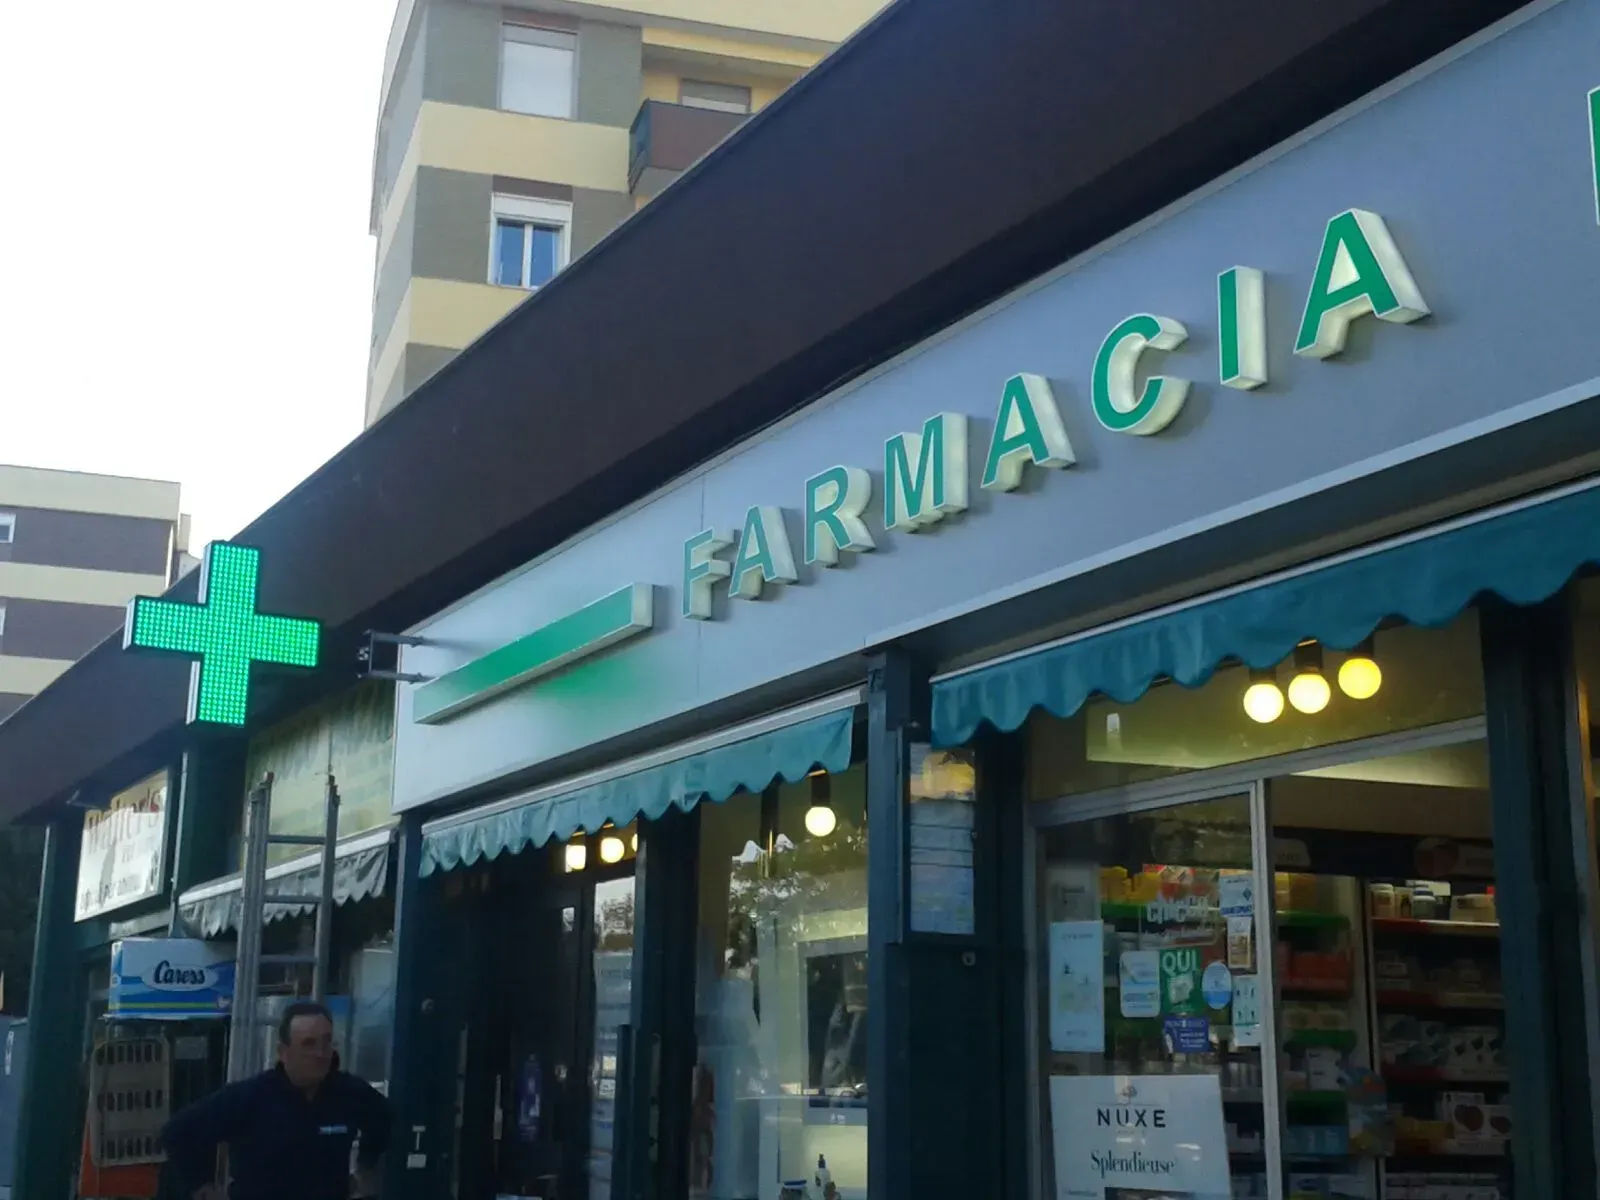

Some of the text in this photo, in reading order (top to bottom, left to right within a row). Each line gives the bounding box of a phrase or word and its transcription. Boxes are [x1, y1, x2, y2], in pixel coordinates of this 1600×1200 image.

[682, 208, 1430, 621] FARMACIA
[154, 960, 205, 985] Caress
[1162, 949, 1198, 974] QUI
[1097, 1108, 1166, 1128] NUXE
[1091, 1149, 1175, 1179] Splendieuse
